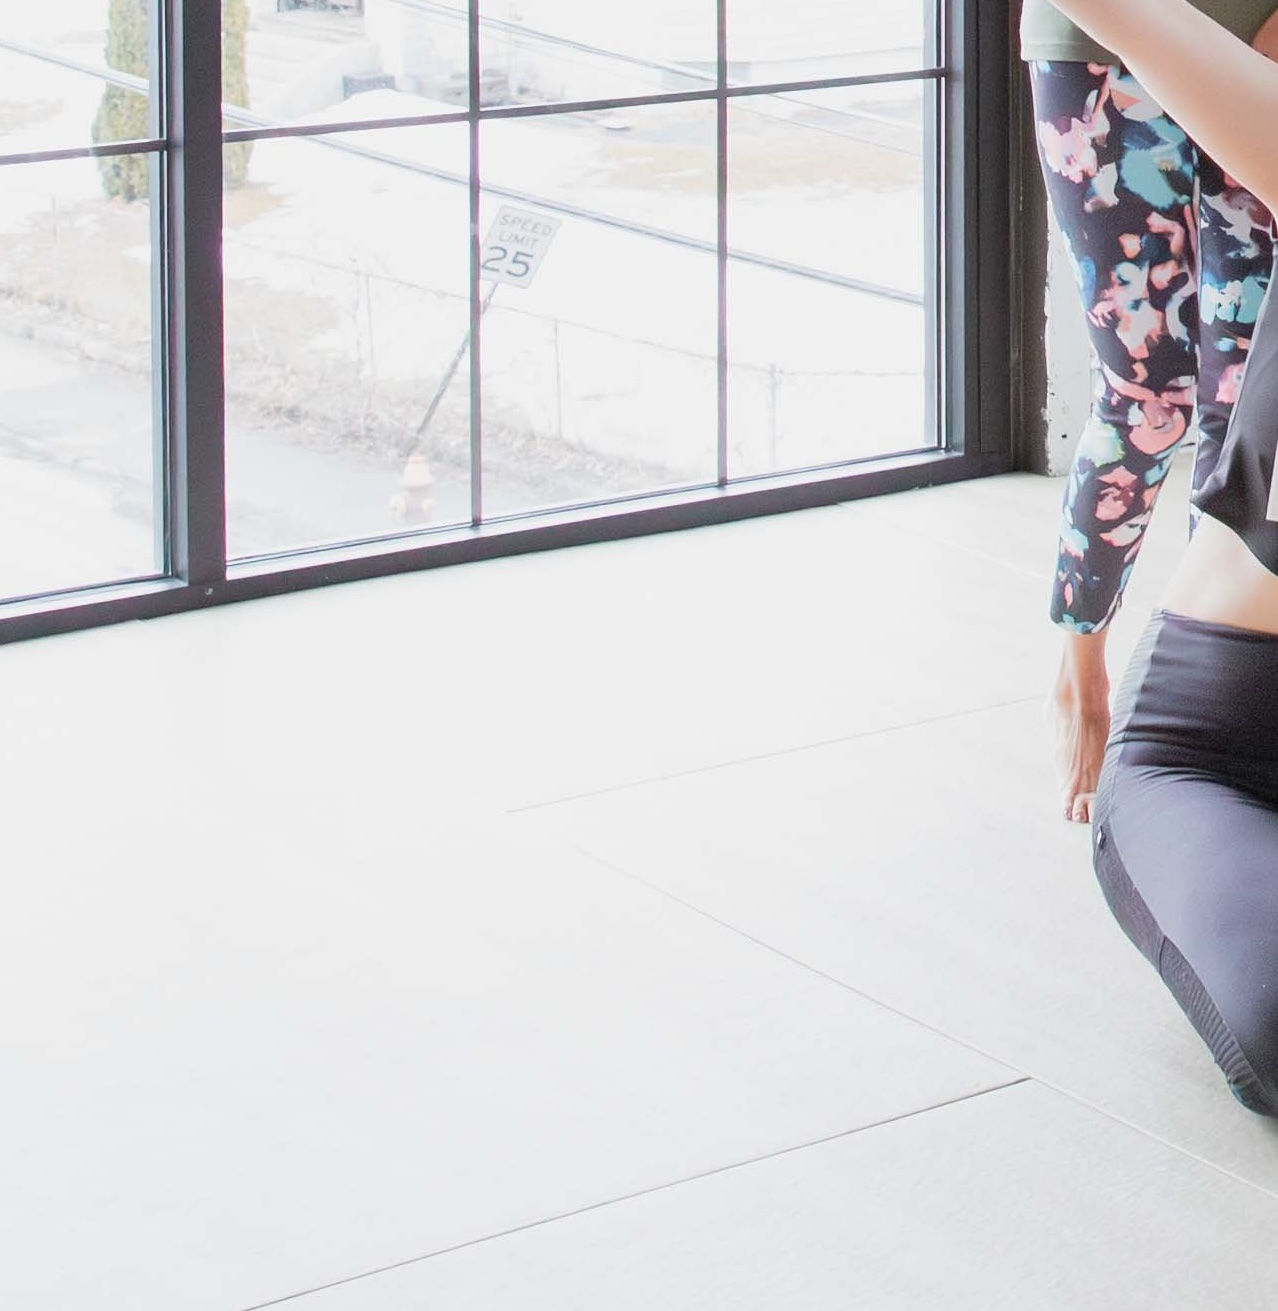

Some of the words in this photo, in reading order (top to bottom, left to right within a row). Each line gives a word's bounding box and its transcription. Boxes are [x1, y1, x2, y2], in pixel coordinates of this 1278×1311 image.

[500, 214, 552, 235] SPEED
[499, 231, 539, 249] LIMIT
[481, 245, 534, 278] 25
